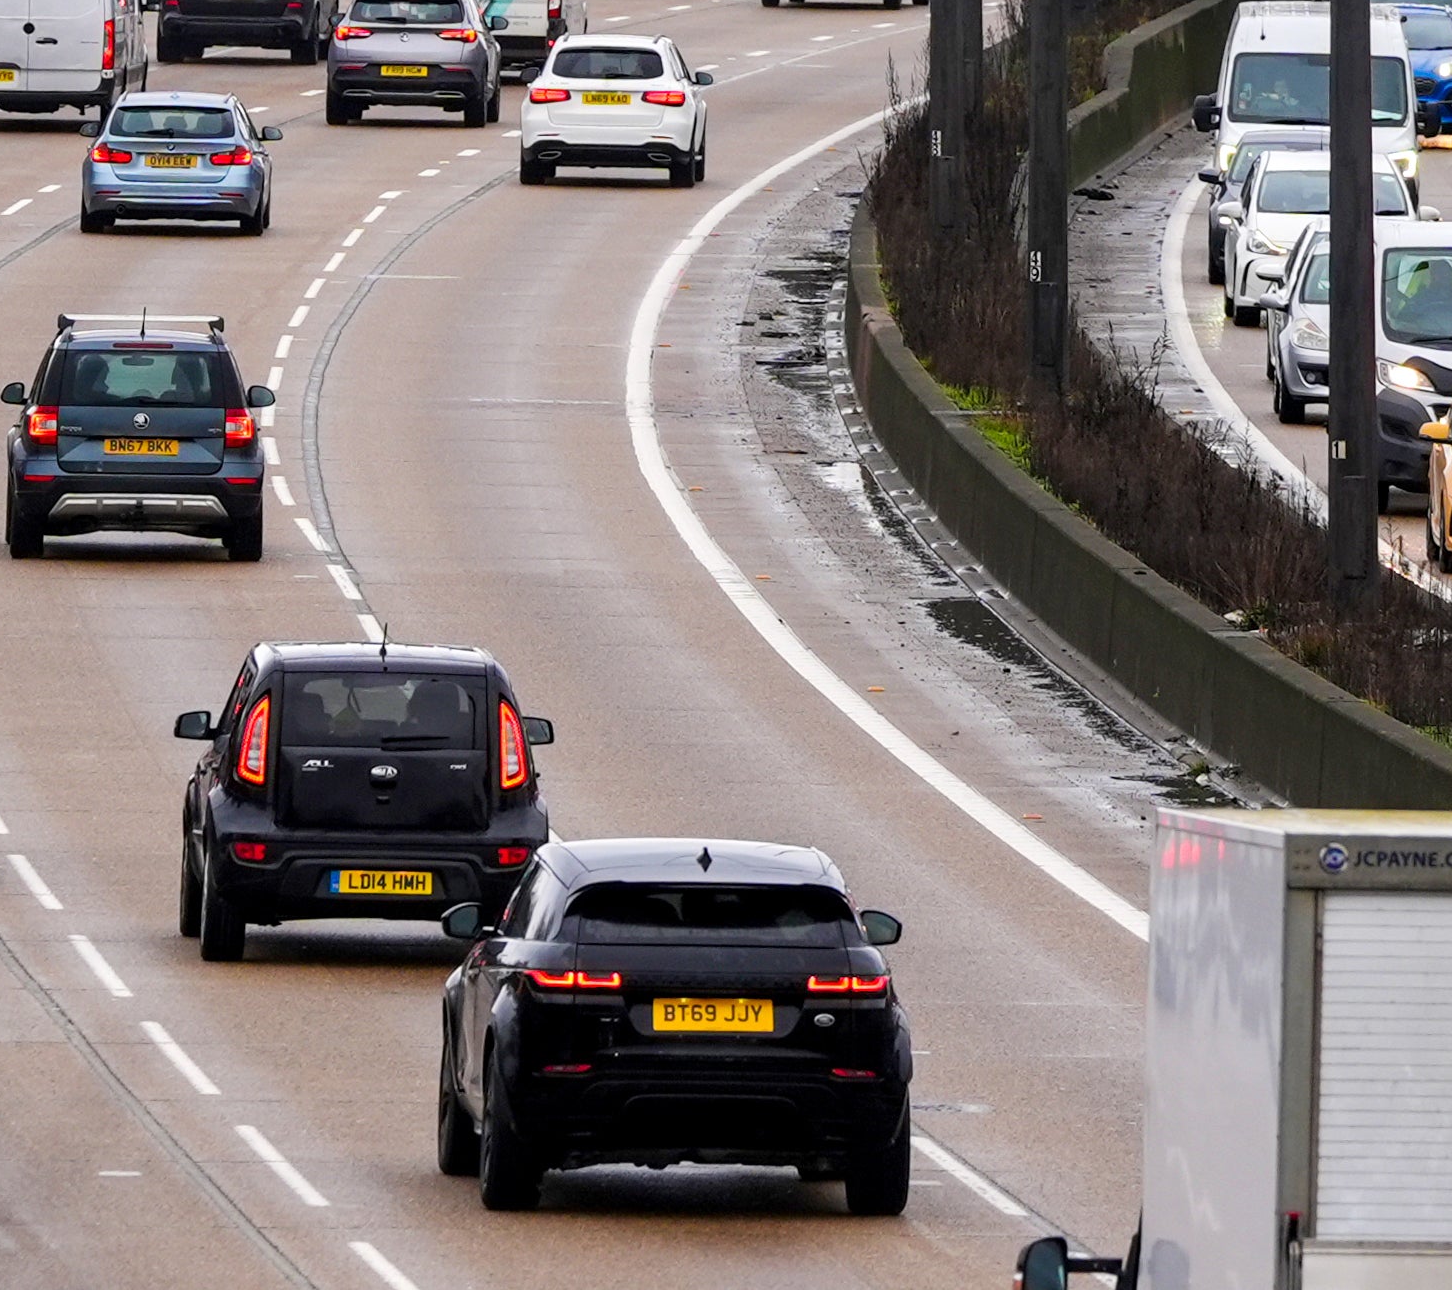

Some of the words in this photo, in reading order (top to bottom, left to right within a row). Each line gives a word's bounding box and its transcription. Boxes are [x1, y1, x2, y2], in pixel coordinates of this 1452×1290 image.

[109, 439, 143, 452] BN67
[147, 440, 173, 453] BKK
[348, 873, 387, 889] LD14
[392, 874, 426, 891] HMH
[663, 1004, 717, 1022] BT69
[723, 1005, 762, 1023] JJY
